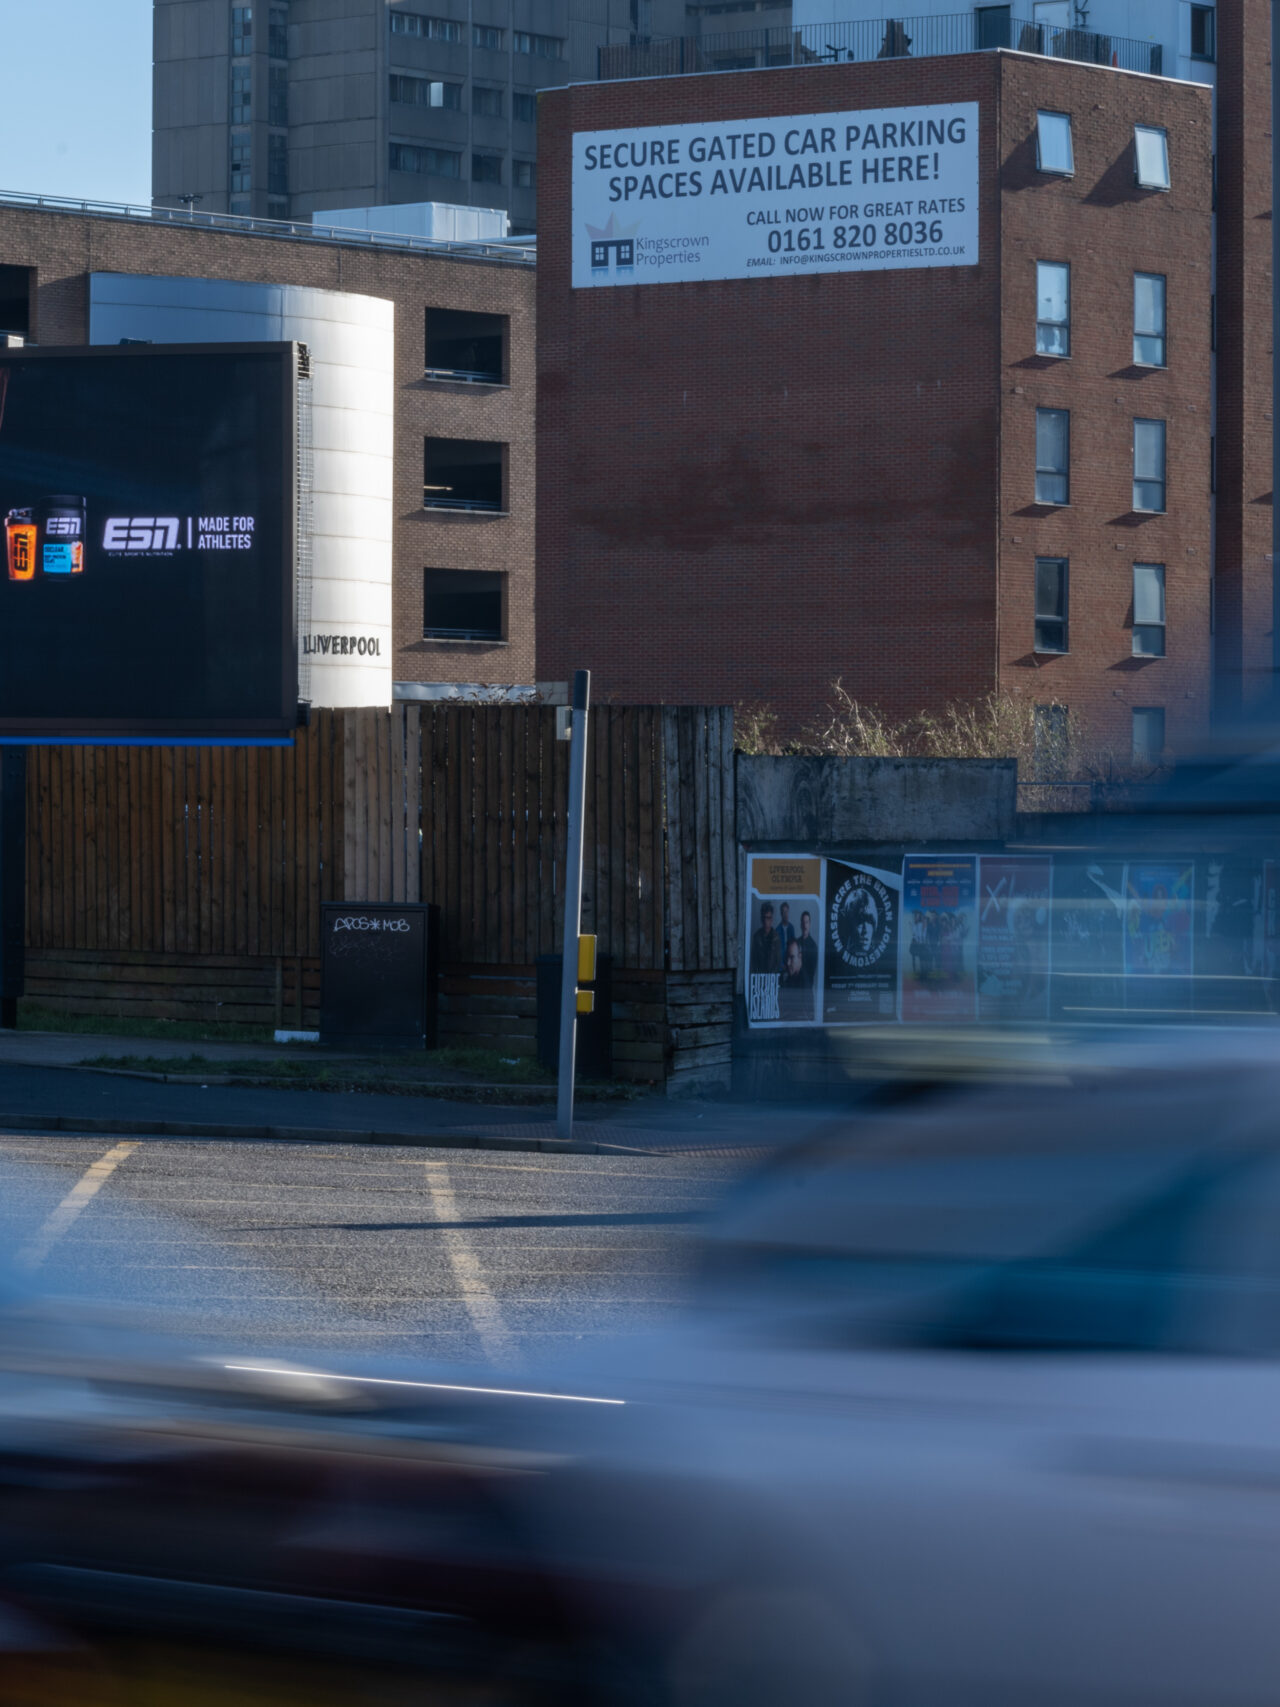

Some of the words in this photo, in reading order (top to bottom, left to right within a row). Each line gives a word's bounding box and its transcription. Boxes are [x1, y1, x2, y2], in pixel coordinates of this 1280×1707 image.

[584, 139, 680, 171] SECURE
[688, 132, 776, 163] GATED
[784, 126, 837, 156] CAR
[845, 117, 967, 152] PARKING
[608, 170, 702, 202] SPACES
[710, 160, 853, 196] AVAILABLE
[861, 152, 941, 185] HERE!
[746, 209, 781, 226] CALL
[785, 206, 825, 224] NOW
[829, 203, 859, 221] FOR
[863, 200, 914, 218] GREAT
[918, 197, 966, 215] RATES
[636, 235, 710, 253] Kingscrown
[767, 227, 825, 253] 0161
[832, 223, 877, 249] 820
[883, 219, 944, 246] 8036
[636, 250, 701, 269] Properties
[746, 257, 776, 268] EMAIL:
[780, 246, 966, 266] INFO@KINGSCROWNPROPERTIESLTD.CO.UK
[198, 516, 230, 532] MADE
[233, 516, 255, 532] FOR
[198, 534, 252, 550] ATHLETES
[303, 634, 381, 656] LIVERPOOL
[852, 873, 873, 886] THE
[873, 881, 893, 921] BRIAN
[830, 879, 852, 952] MASSACRE
[842, 925, 892, 968] JONESTOWN
